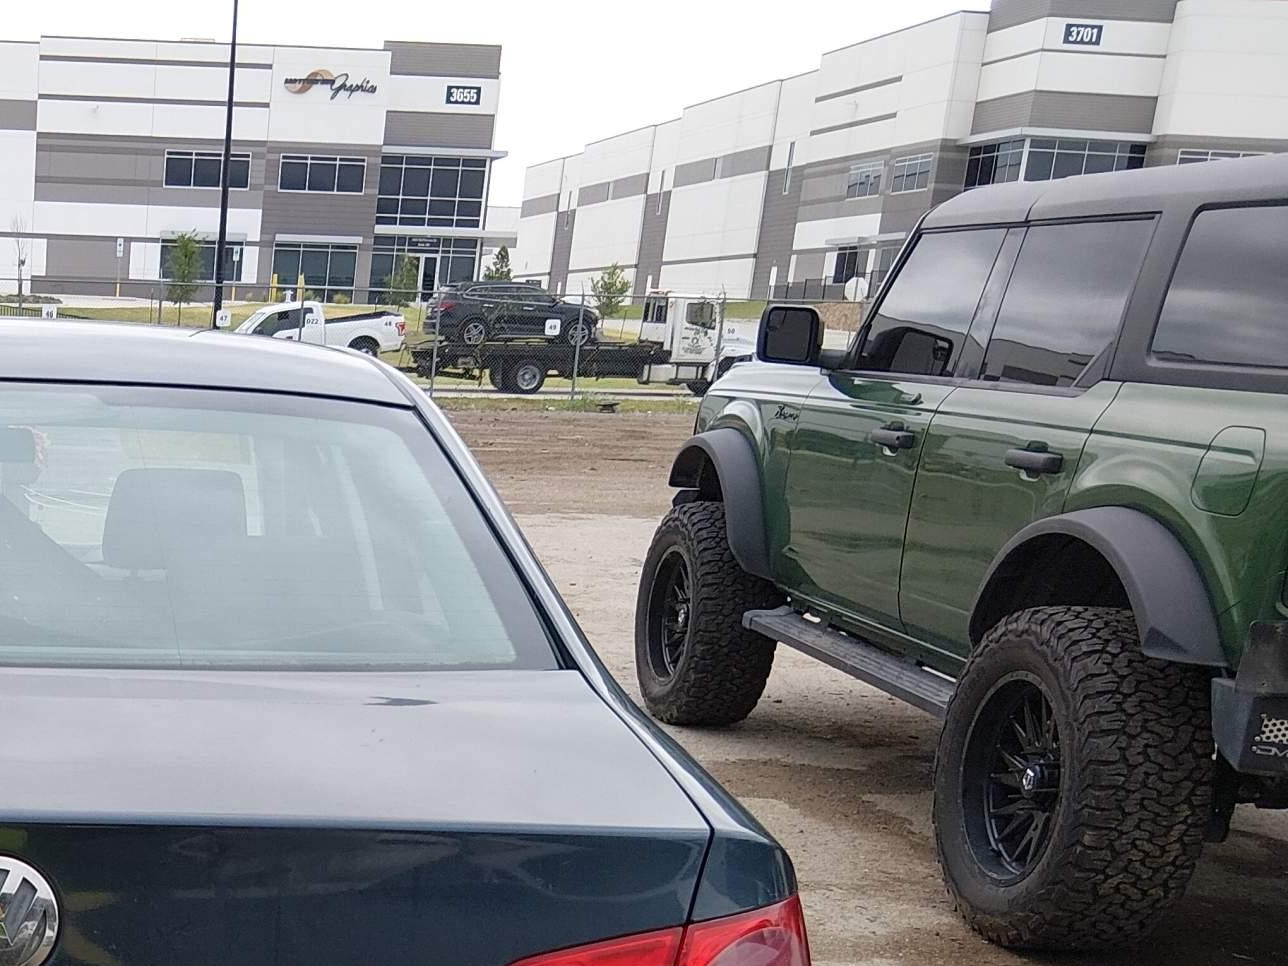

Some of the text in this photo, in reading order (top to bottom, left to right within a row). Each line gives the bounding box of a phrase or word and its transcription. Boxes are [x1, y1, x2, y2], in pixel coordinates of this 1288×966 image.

[1068, 26, 1098, 42] 3701
[330, 73, 378, 100] Graphics
[450, 88, 478, 102] 3655
